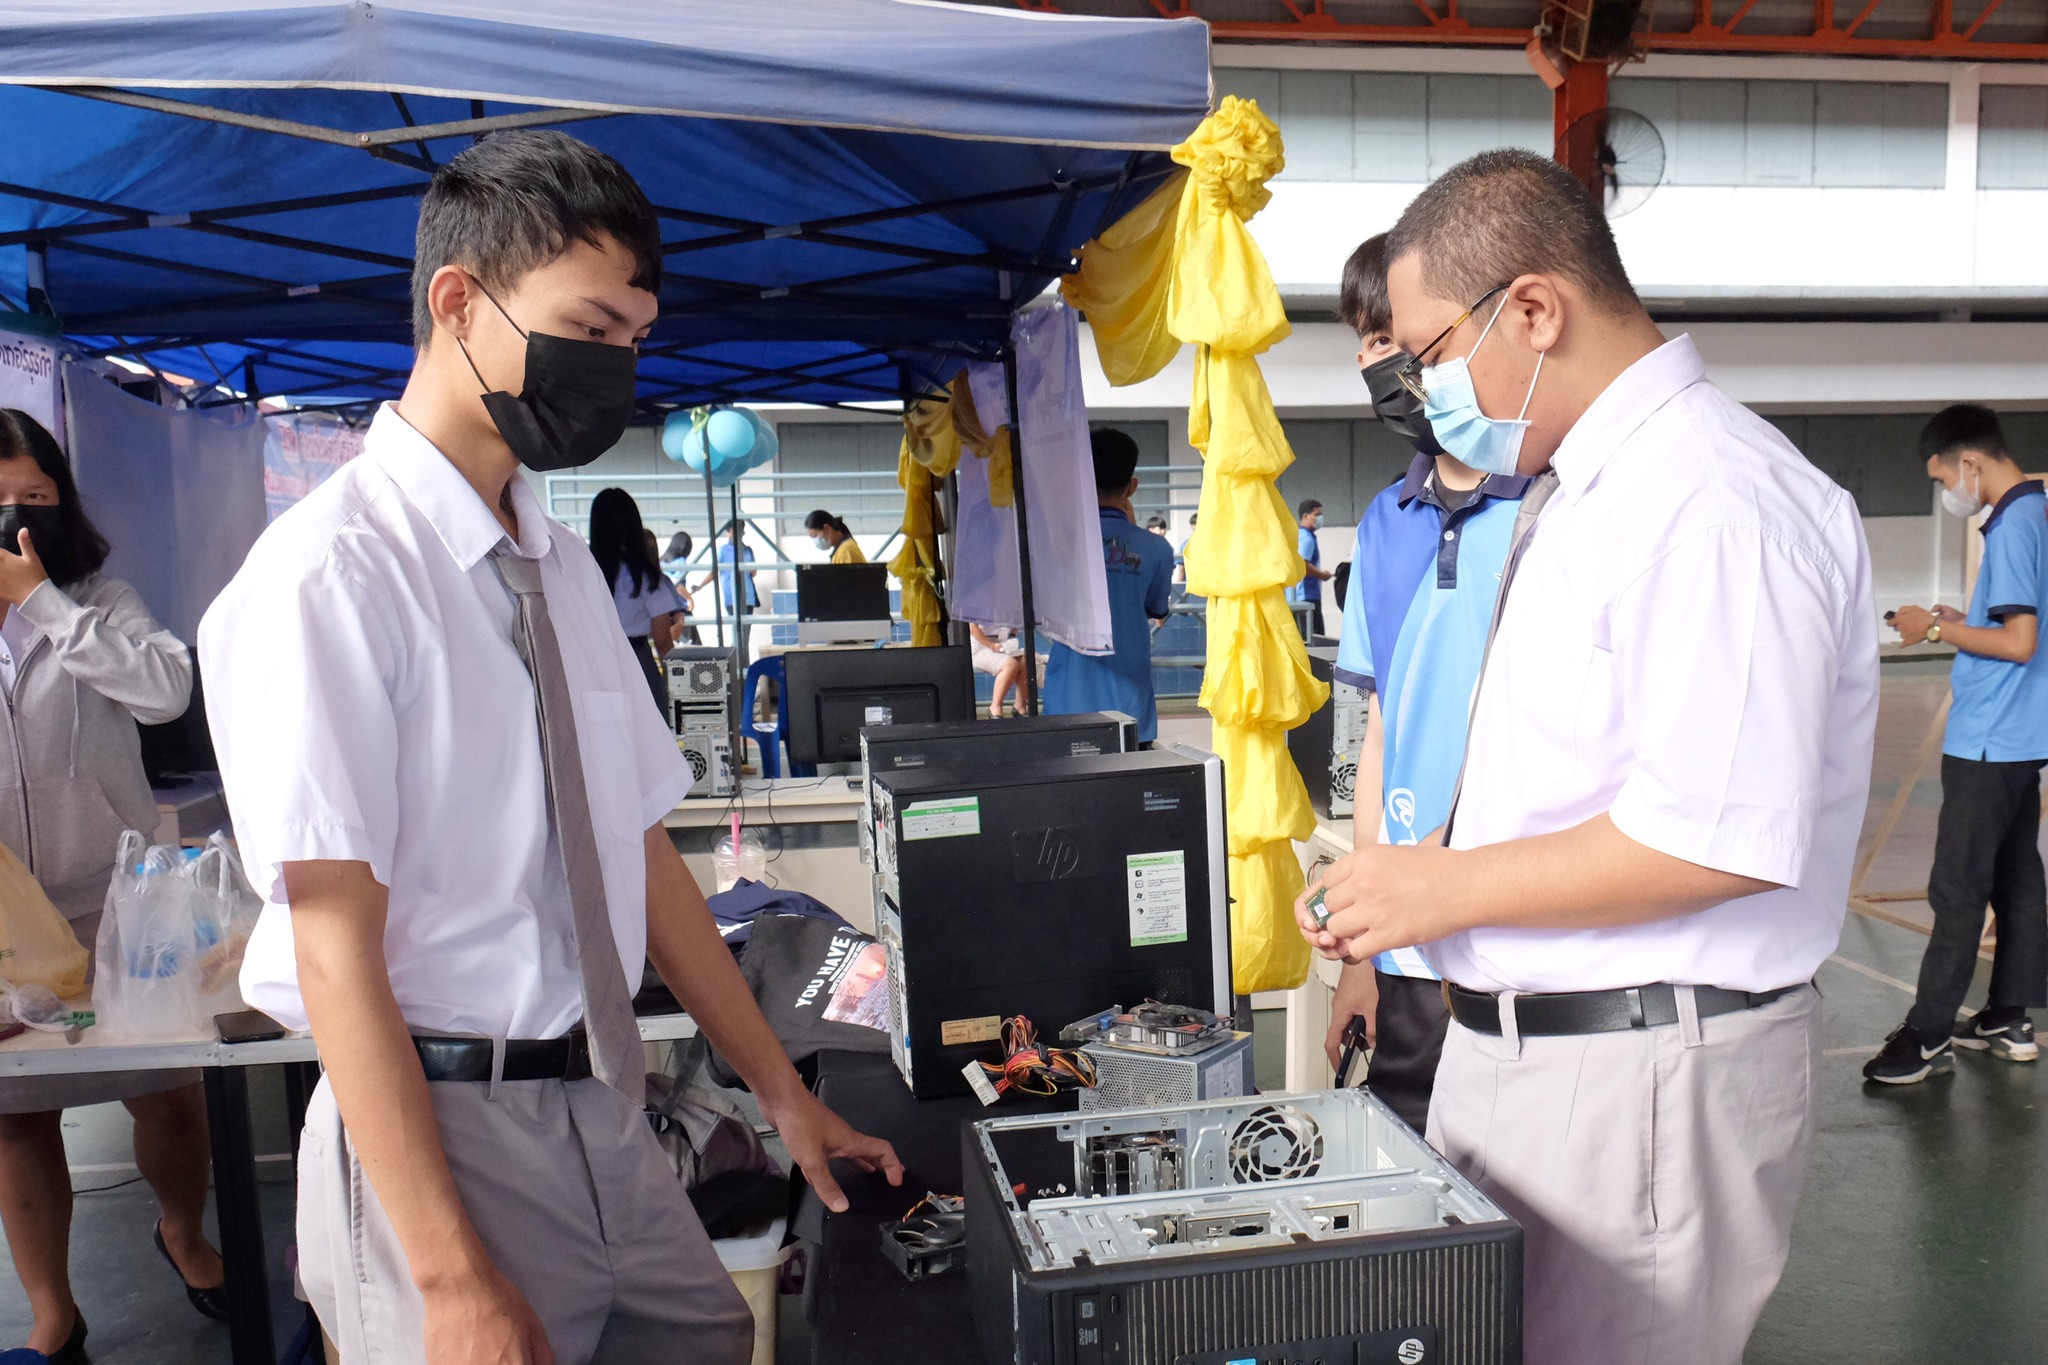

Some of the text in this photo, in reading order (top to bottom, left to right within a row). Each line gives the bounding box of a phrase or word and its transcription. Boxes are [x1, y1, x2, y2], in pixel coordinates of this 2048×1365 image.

[795, 979, 825, 1008] YOU
[816, 936, 851, 976] HAVE
[1398, 1340, 1424, 1362] hp
